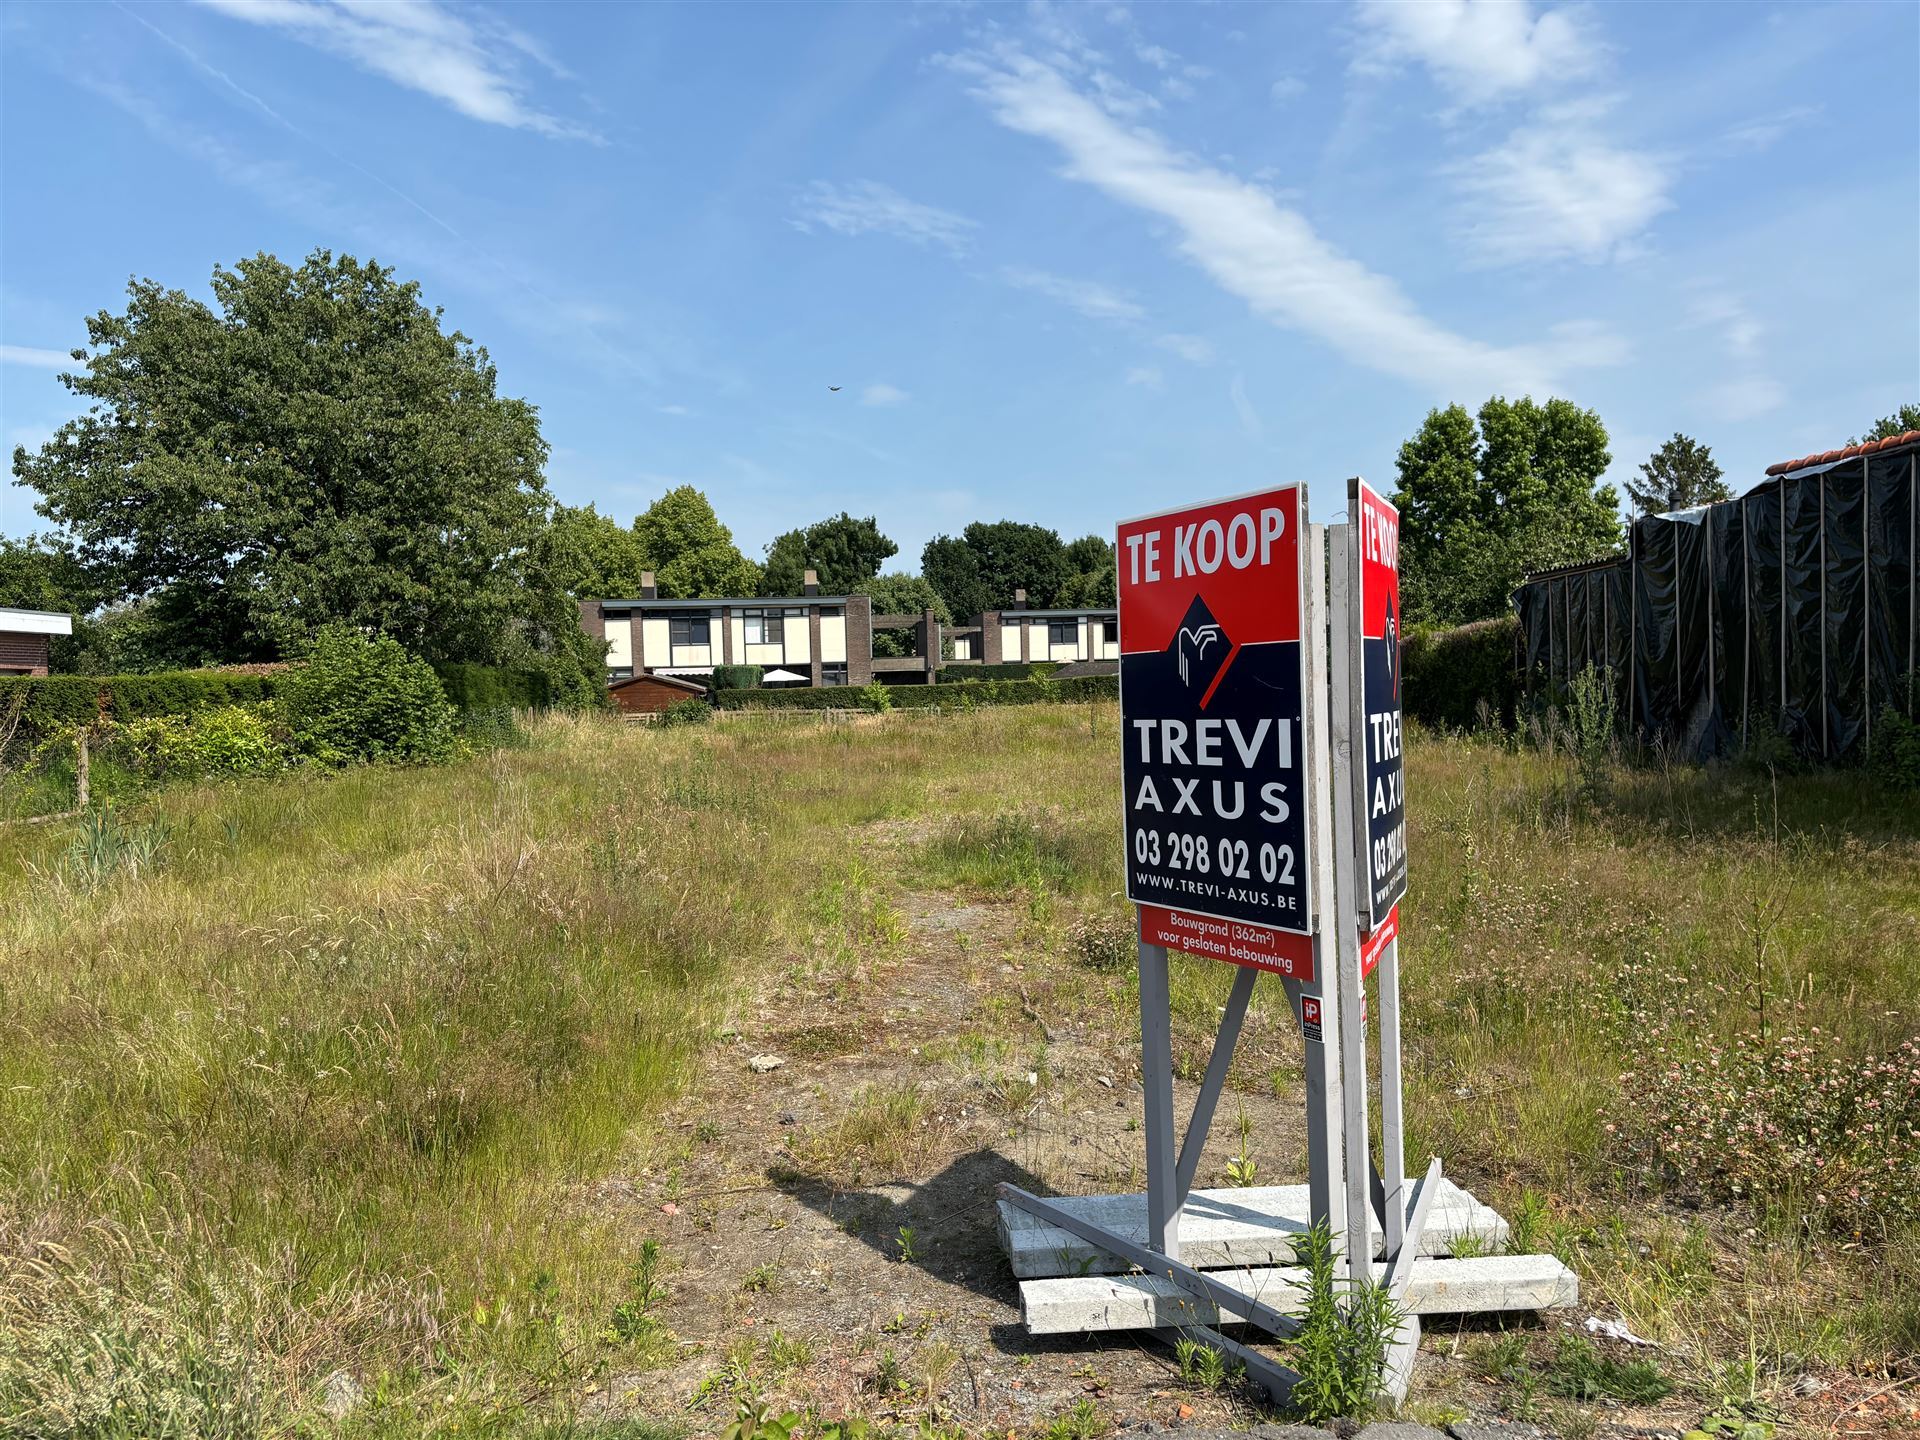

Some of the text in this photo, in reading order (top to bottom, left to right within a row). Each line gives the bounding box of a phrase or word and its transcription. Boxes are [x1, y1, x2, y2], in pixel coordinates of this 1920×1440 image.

[1126, 507, 1285, 585] TE KOOP
[1364, 502, 1397, 572] TE KOO
[1133, 718, 1292, 768] TREVI
[1370, 710, 1401, 763] TRE
[1134, 775, 1290, 823] AXUS
[1372, 768, 1401, 819] AXU
[1135, 828, 1295, 885] 03 298 02 02
[1374, 836, 1386, 880] 03
[1136, 872, 1297, 910] WWW.TREVI-AXUS.BE
[1170, 912, 1229, 937] Bouwgrond
[1157, 930, 1293, 974] voor gesloten bebouwing
